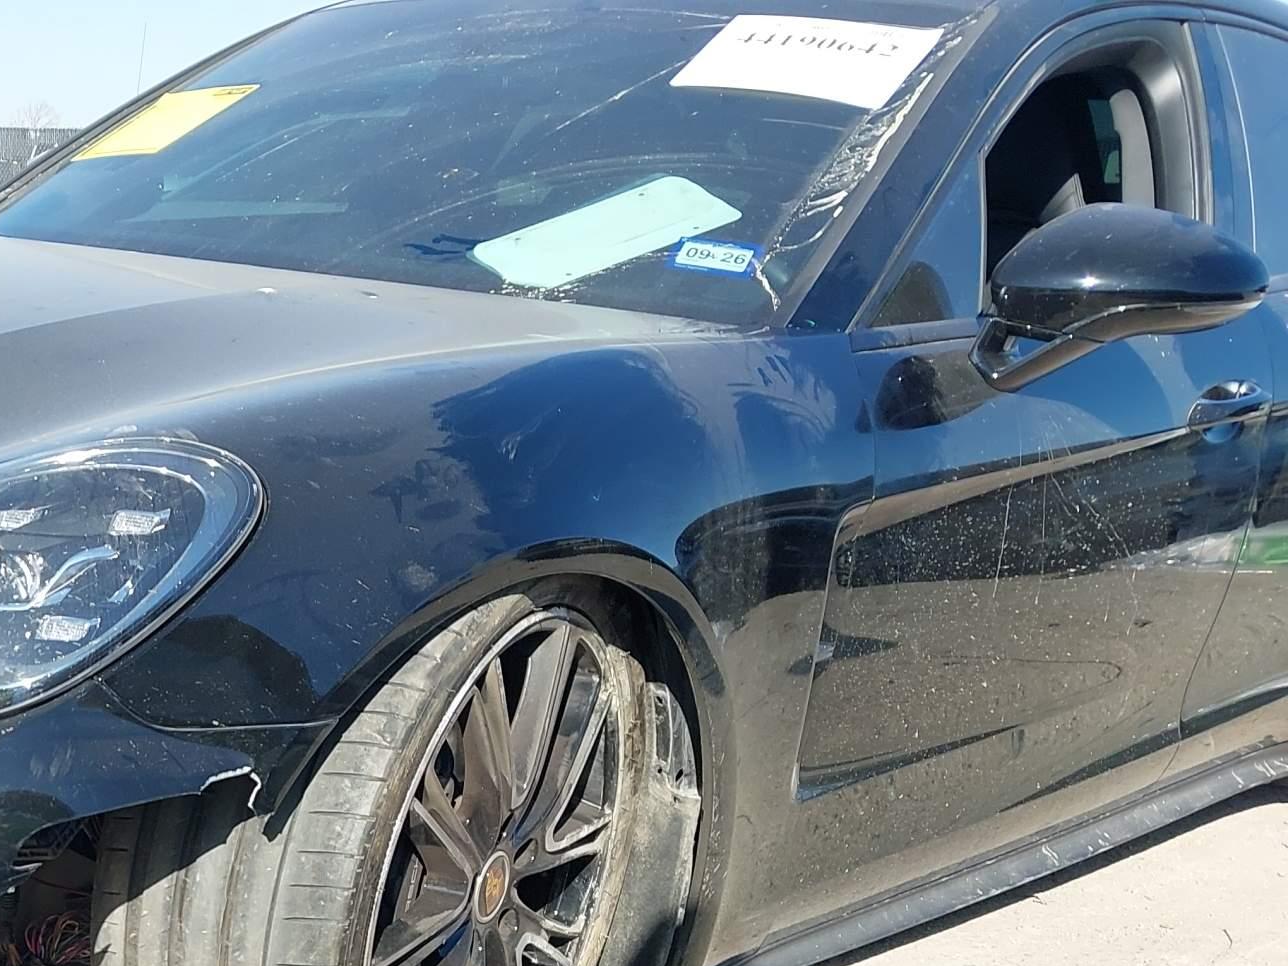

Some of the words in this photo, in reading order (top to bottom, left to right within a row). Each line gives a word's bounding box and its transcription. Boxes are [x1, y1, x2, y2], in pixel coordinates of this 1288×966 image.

[737, 32, 900, 57] 44190642
[685, 247, 711, 260] 09
[719, 251, 747, 265] 26
